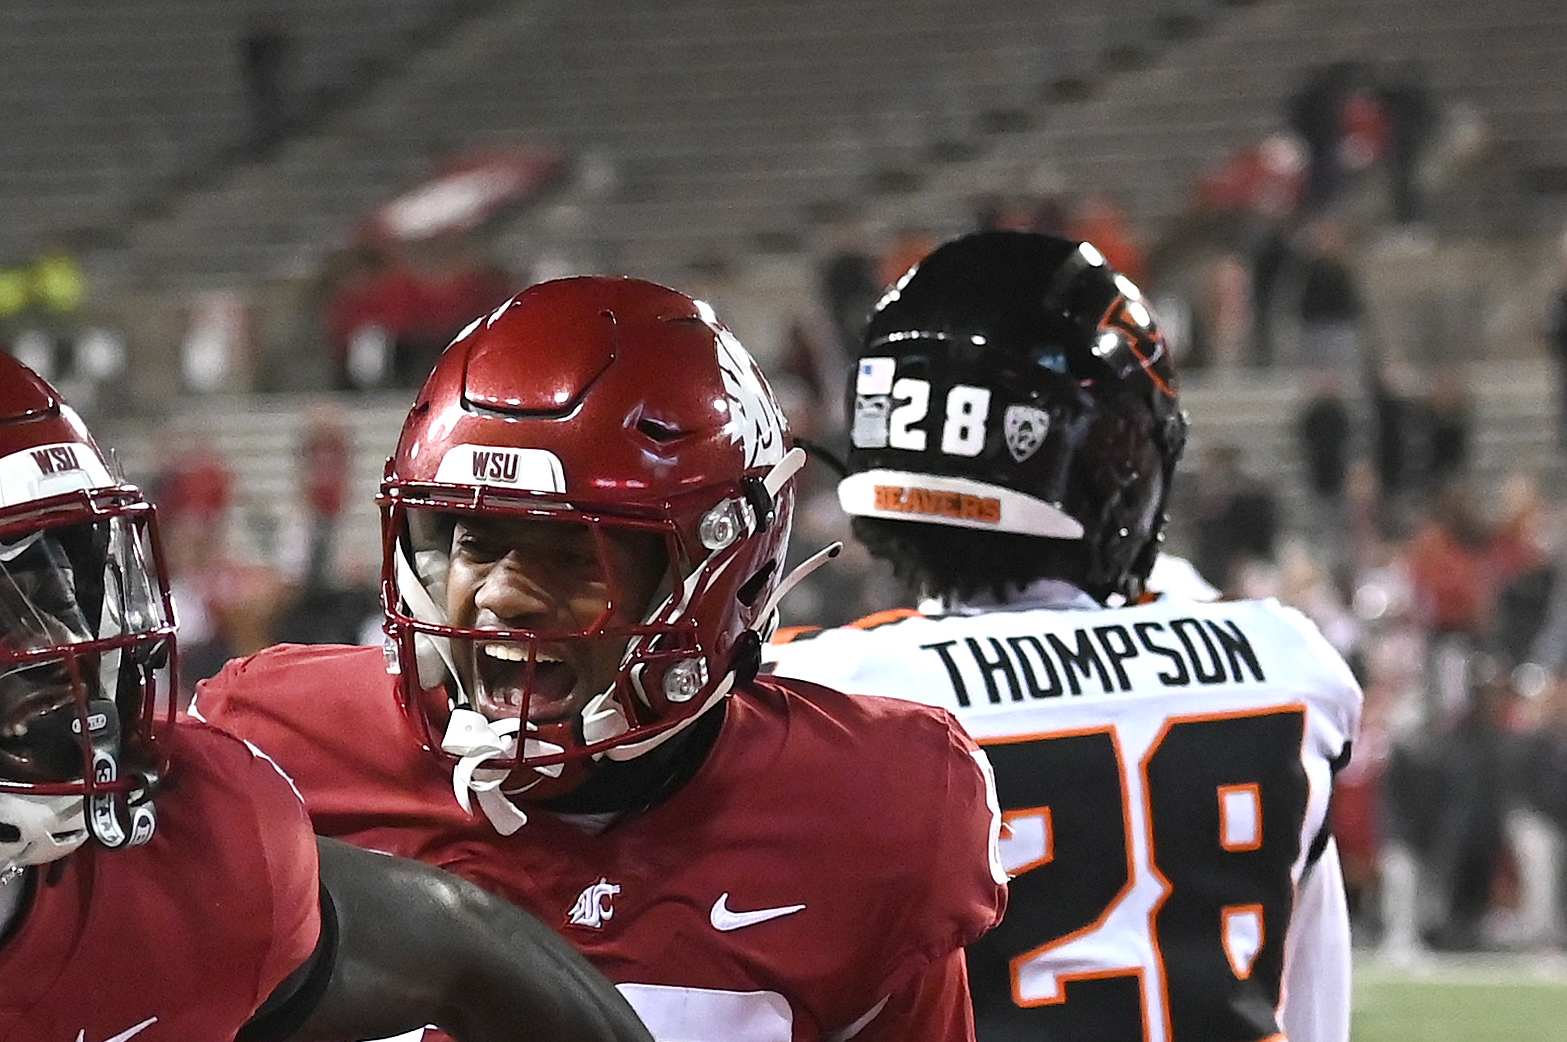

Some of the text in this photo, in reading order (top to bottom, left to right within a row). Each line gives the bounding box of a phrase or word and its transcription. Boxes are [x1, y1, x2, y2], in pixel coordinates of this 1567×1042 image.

[889, 377, 993, 458] 28
[29, 446, 81, 475] WSU
[472, 450, 519, 480] WSU
[874, 485, 1001, 523] BEAVERS
[919, 617, 1266, 707] THOMPSON
